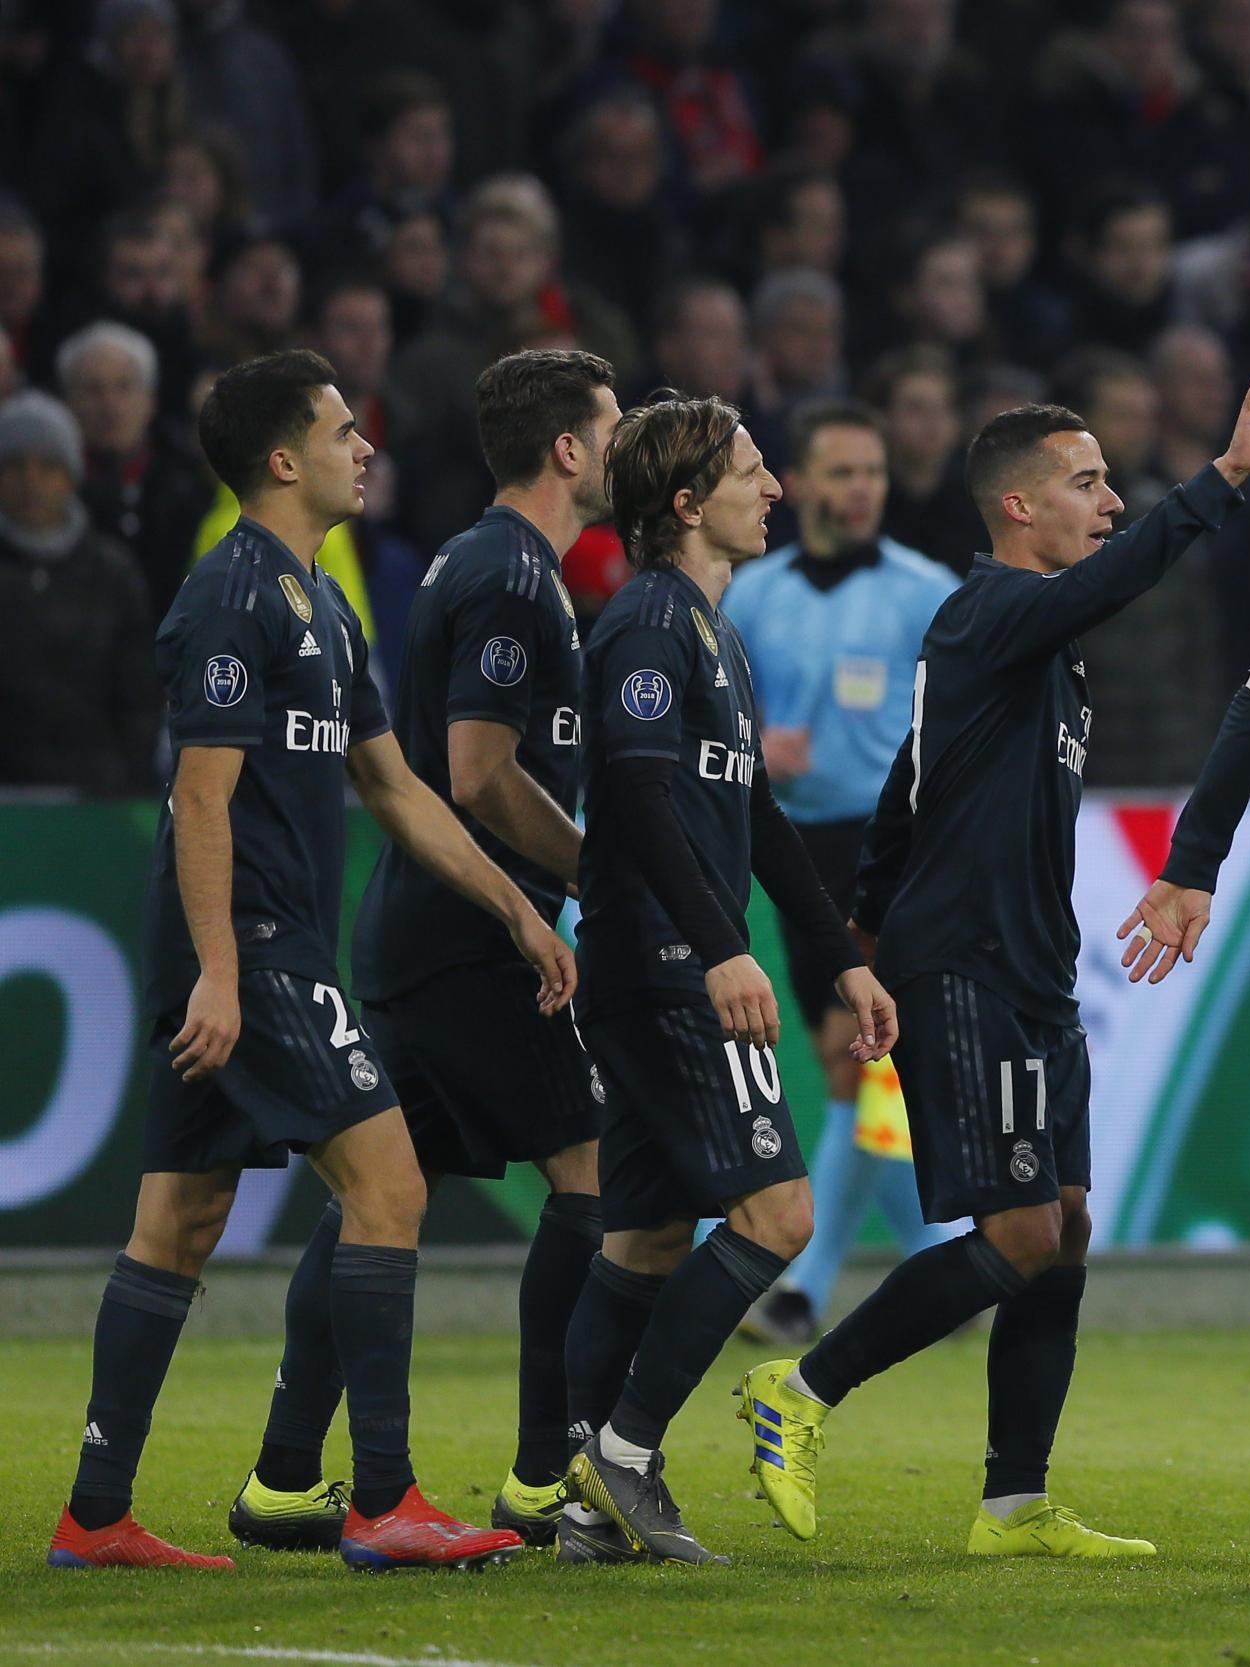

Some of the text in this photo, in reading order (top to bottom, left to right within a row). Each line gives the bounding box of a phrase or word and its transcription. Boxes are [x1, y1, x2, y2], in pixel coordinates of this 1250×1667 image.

[298, 646, 322, 657] adidas
[724, 1039, 781, 1113] 10
[1000, 1058, 1047, 1134] 17
